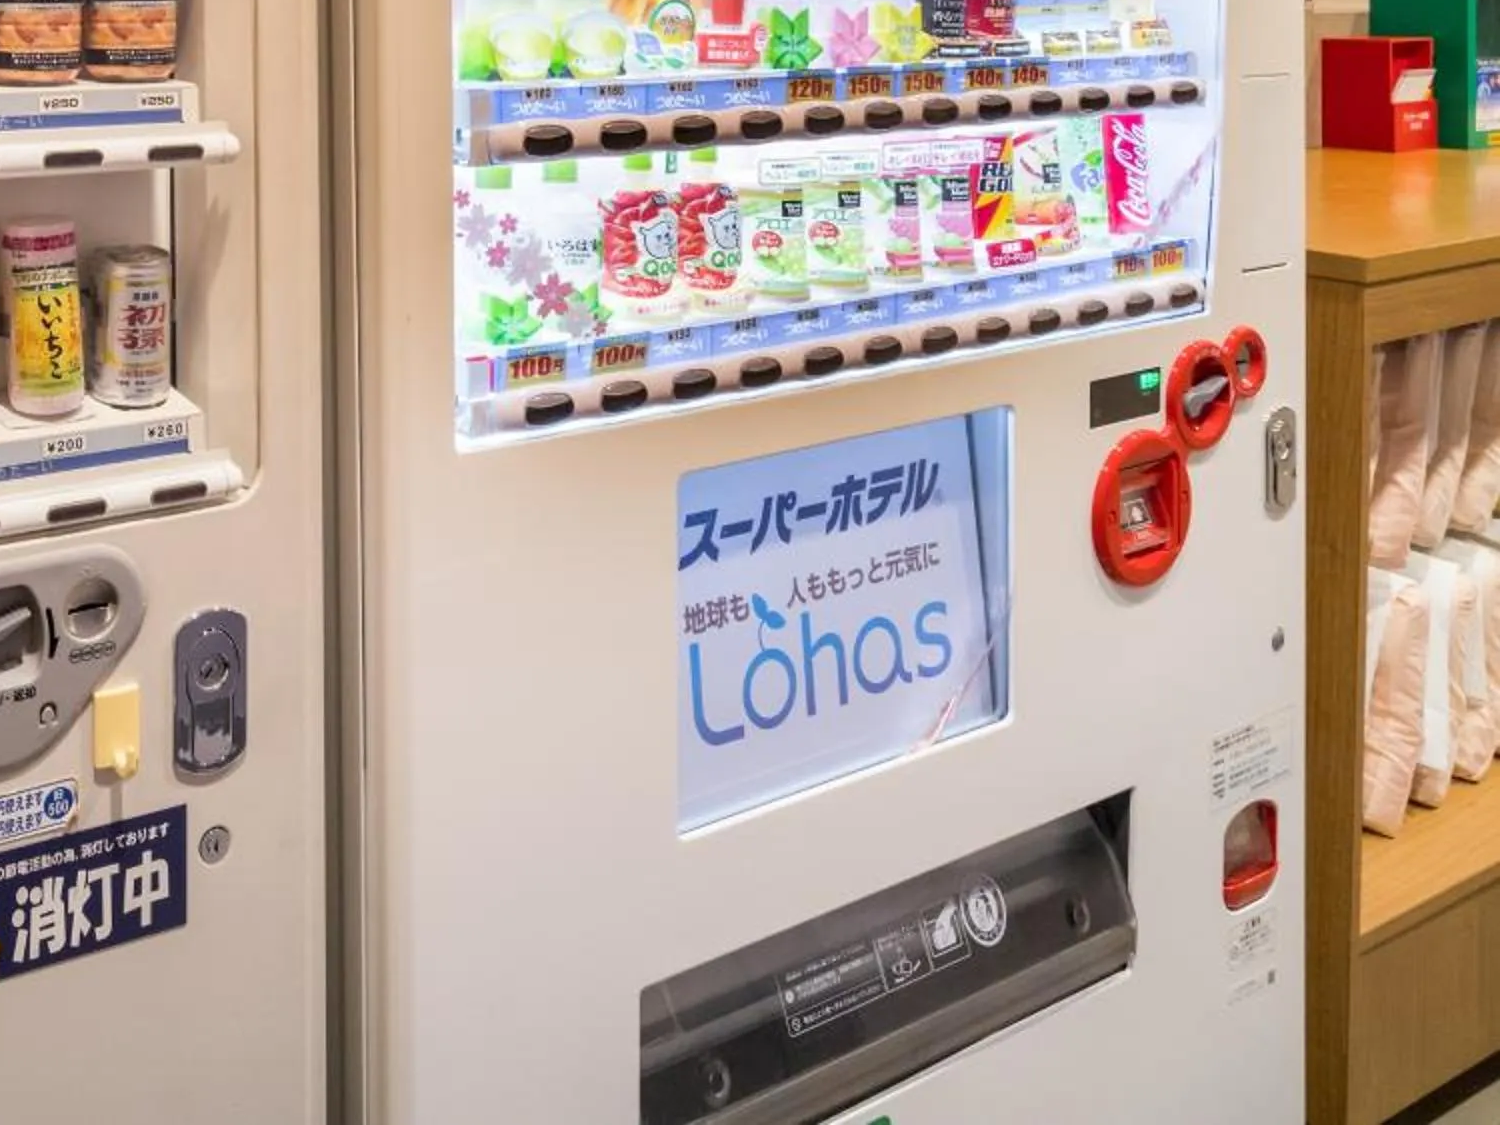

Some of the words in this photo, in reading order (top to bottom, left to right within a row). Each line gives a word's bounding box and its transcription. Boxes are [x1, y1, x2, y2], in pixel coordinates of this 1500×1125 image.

[36, 294, 64, 380] いいちこ
[594, 343, 647, 369] 100円
[508, 356, 565, 380] 100円
[47, 437, 84, 453] ¥200
[147, 424, 184, 438] ¥260
[678, 457, 940, 572] スーパーホテル
[786, 541, 941, 609] 人ももっと元気に
[683, 594, 751, 636] 地球も
[689, 600, 953, 747] Lohas
[11, 850, 170, 965] 消灯中
